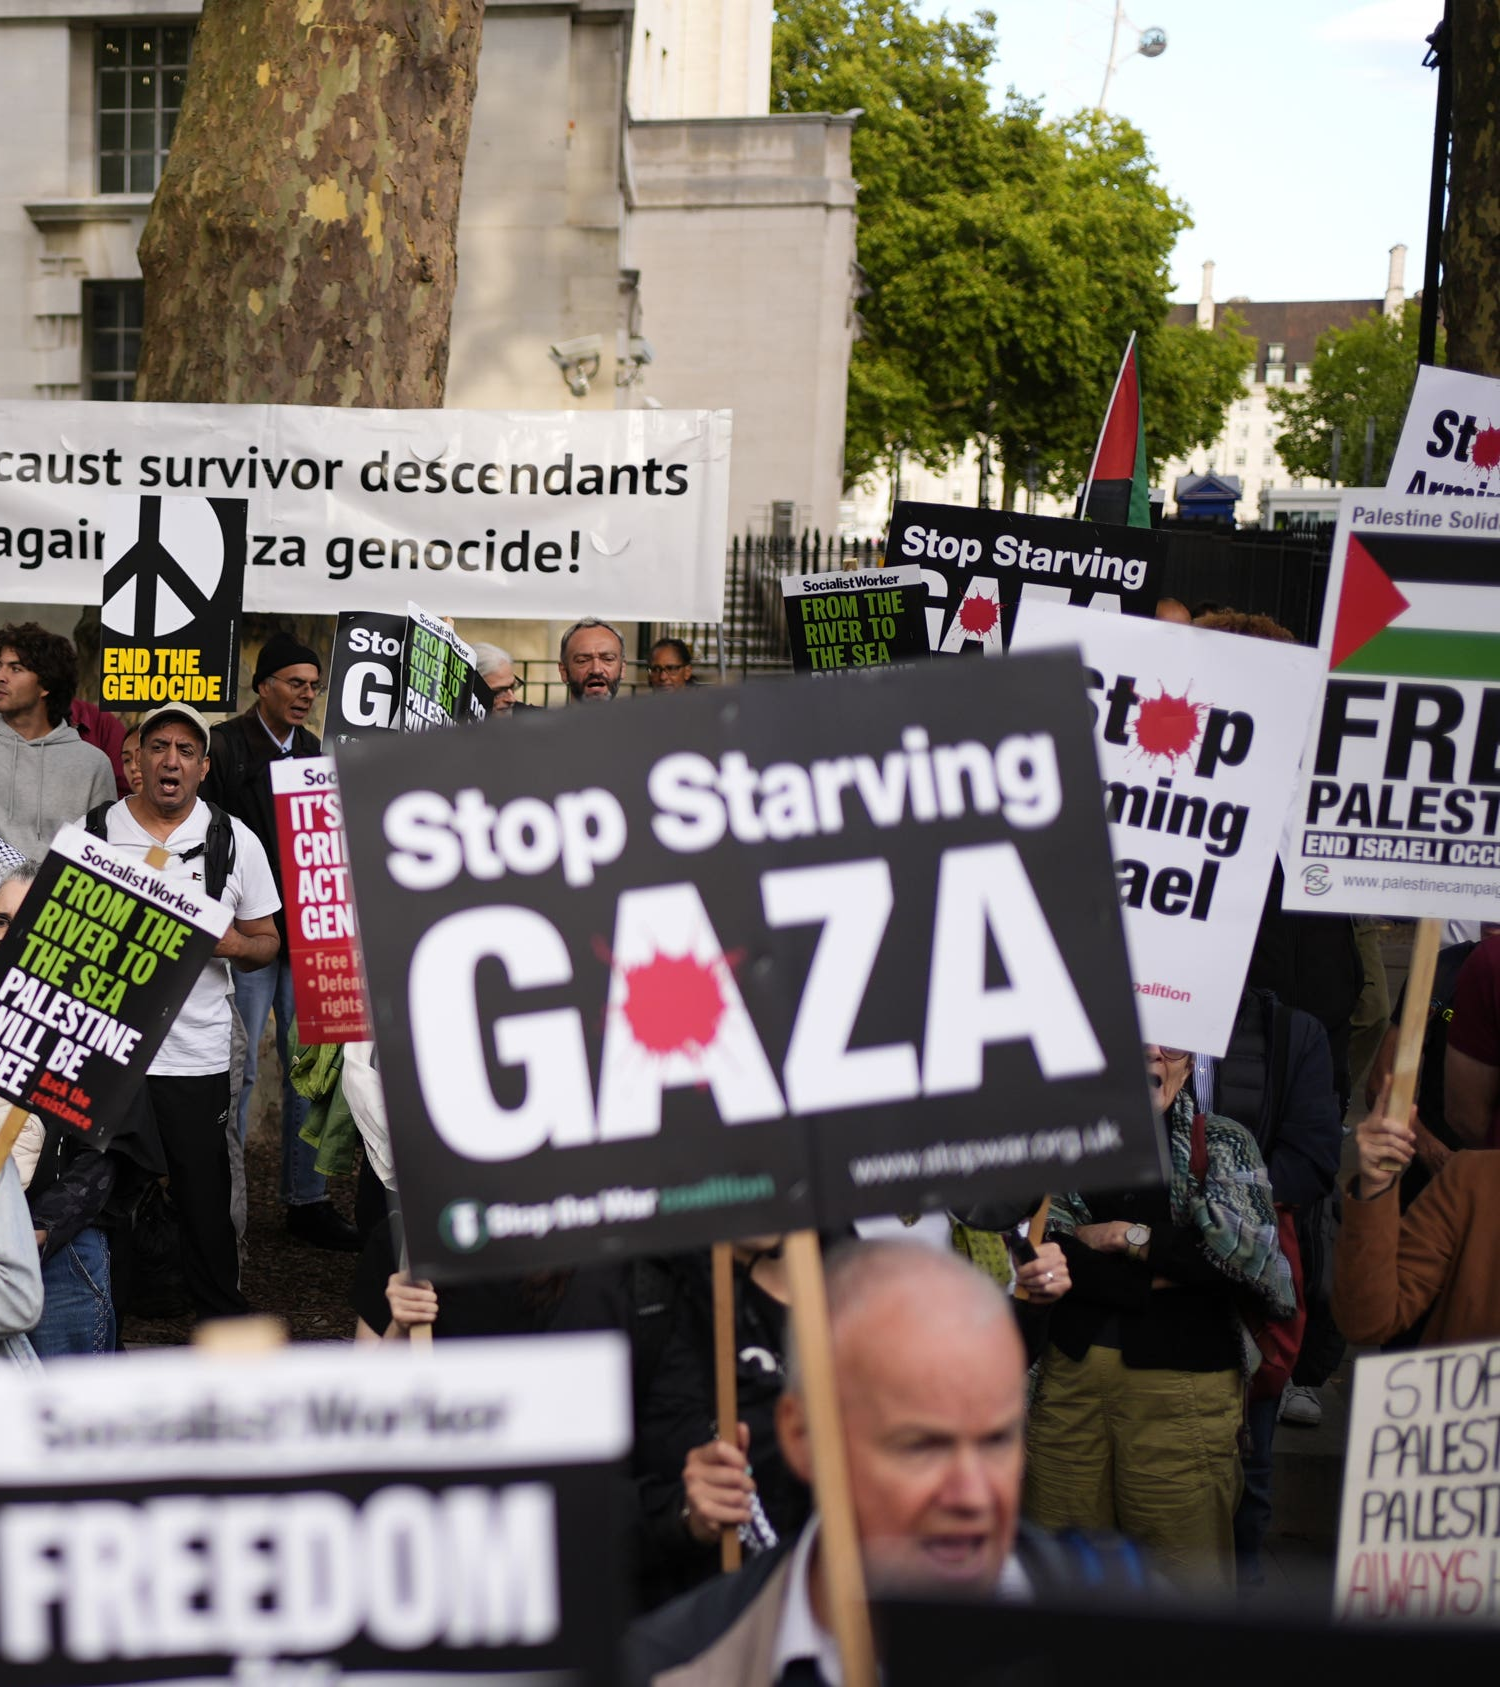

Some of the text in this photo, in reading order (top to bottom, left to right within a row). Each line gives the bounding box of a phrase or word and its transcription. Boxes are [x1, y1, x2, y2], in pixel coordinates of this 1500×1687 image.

[139, 445, 343, 491] survivor
[360, 449, 689, 497] descendants
[1352, 505, 1443, 531] Palestine
[246, 535, 305, 570] za
[325, 529, 581, 581] genocide!
[901, 525, 1148, 590] Stop Starving
[803, 574, 900, 592] Socialist Worker
[800, 590, 905, 622] FROM THE
[348, 627, 404, 663] Sto
[804, 616, 896, 646] RIVER TO
[103, 648, 201, 675] END THE
[410, 649, 448, 684] RIVER
[413, 625, 469, 683] FROM THE
[807, 641, 891, 670] THE SEA
[102, 674, 222, 702] GENOCIDE
[409, 665, 431, 699] THE
[383, 726, 1064, 891] Stop Starving
[1102, 777, 1250, 858] ming
[1304, 833, 1351, 857] END
[1355, 837, 1444, 863] ISRAELI
[80, 843, 203, 920] Socialist Worker
[298, 867, 349, 904] ACT
[1116, 857, 1221, 921] ael
[1305, 874, 1328, 886] PSC
[51, 863, 193, 962] FROM THE
[32, 898, 159, 987] RIVER TO
[16, 932, 129, 1017] THE SEA
[315, 952, 348, 971] Free
[321, 996, 365, 1019] rights
[407, 841, 1108, 1163] GAZA
[1133, 981, 1192, 1003] oalition
[45, 1035, 93, 1082] BE
[29, 1090, 93, 1132] resistance
[68, 1086, 92, 1110] the
[486, 1198, 549, 1240] Stop
[590, 1185, 660, 1226] War
